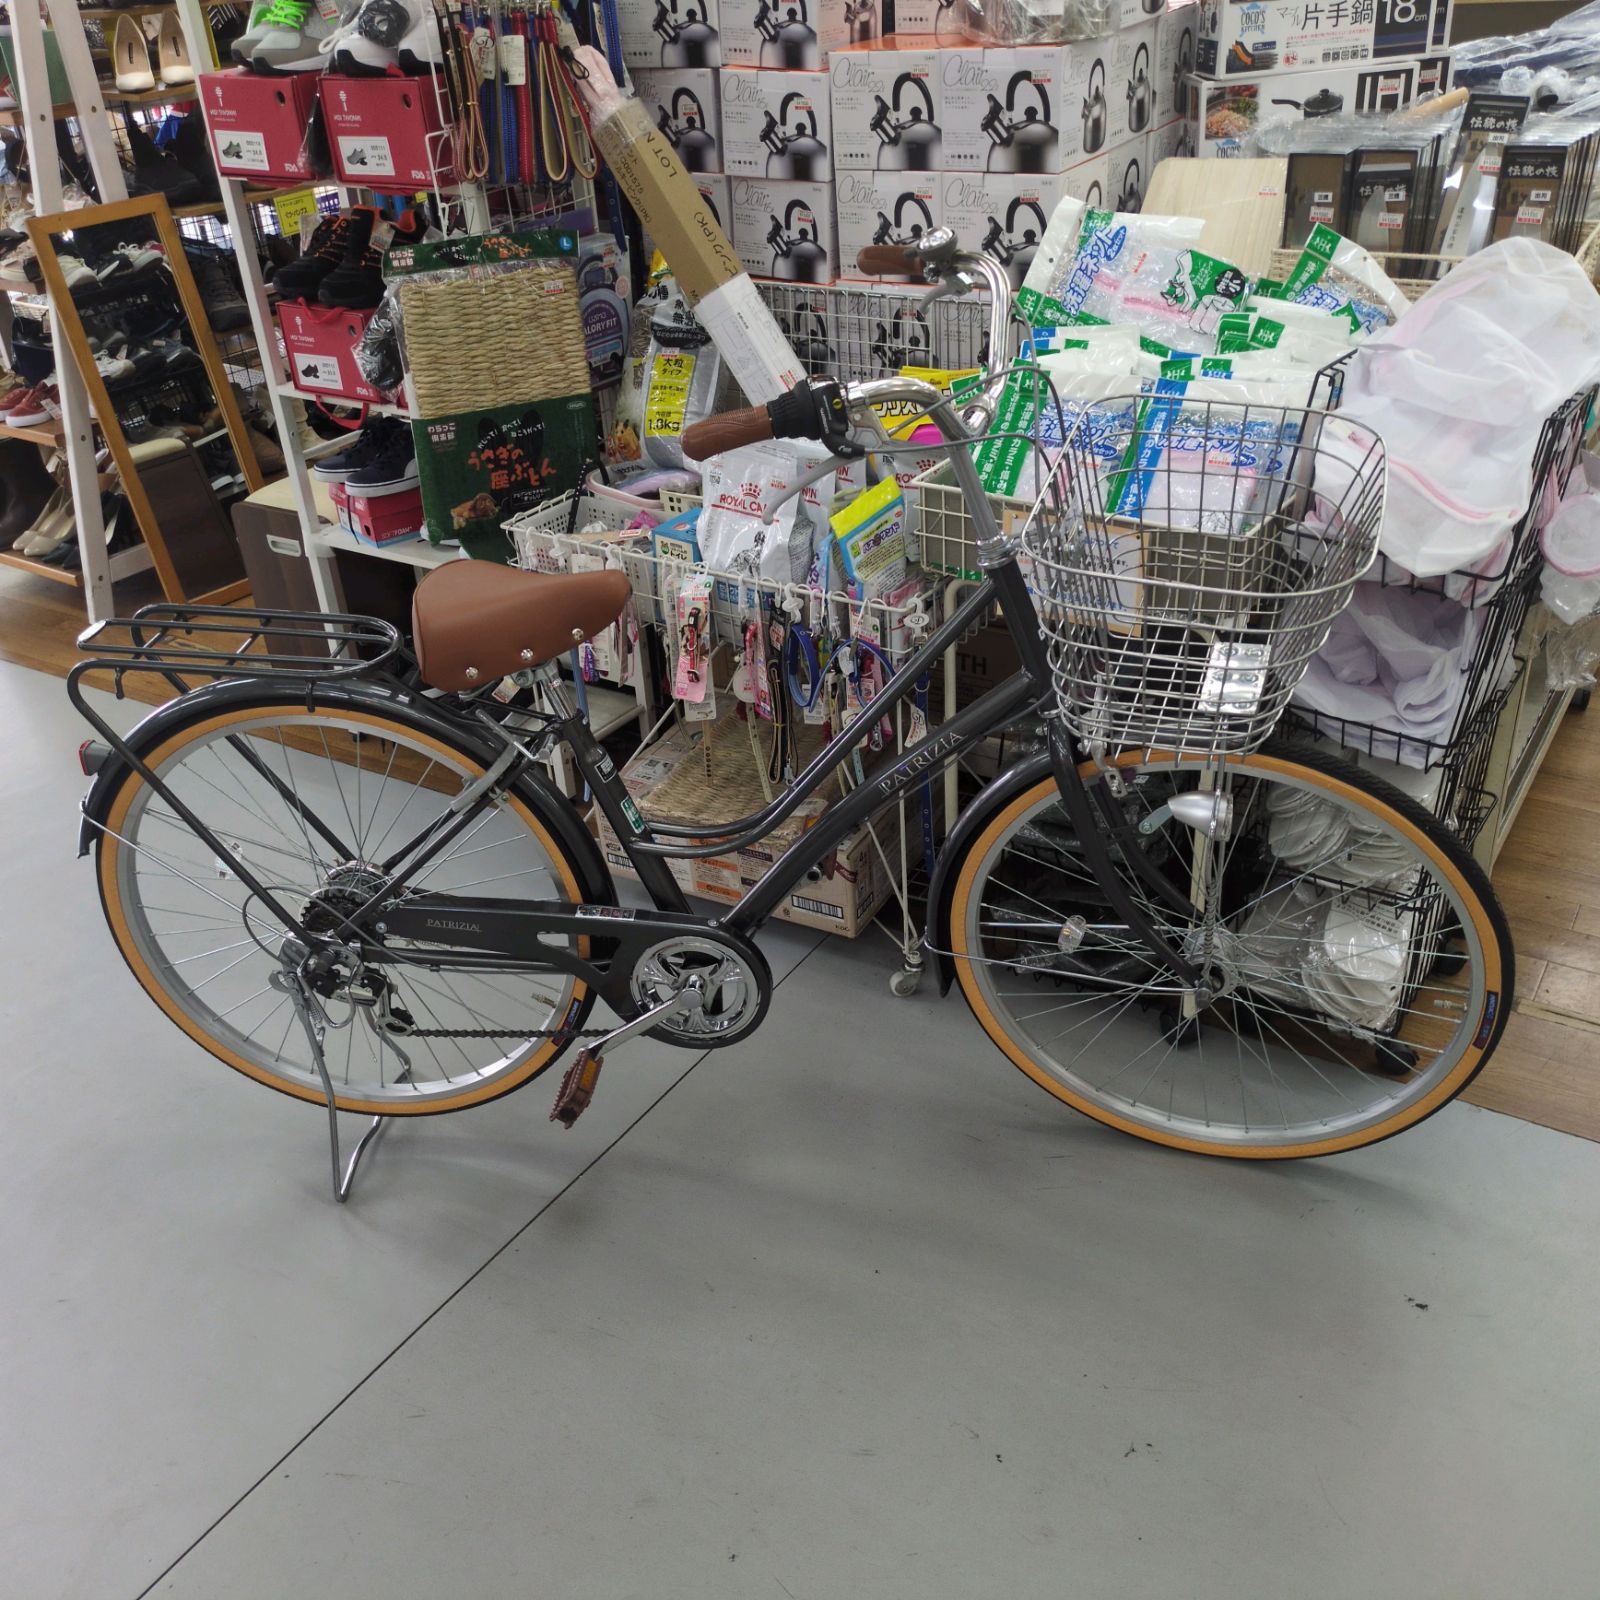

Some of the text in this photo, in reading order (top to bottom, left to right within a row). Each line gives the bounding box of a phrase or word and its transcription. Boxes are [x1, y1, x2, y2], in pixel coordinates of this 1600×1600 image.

[1301, 0, 1374, 31] 片手鍋
[833, 57, 875, 88] Clair
[943, 55, 989, 87] Clair
[653, 147, 678, 178] LOT
[734, 178, 770, 208] Clair
[838, 174, 879, 204] Clair
[945, 177, 989, 208] Clair
[561, 238, 571, 247] L
[663, 358, 685, 368] 大粒
[427, 422, 457, 434] わらっこ
[467, 443, 524, 471] うさぎの
[490, 457, 557, 491] 座ぶとん
[719, 493, 747, 510] ROYAL
[878, 732, 964, 796] PATRIZIA
[426, 918, 480, 931] PATRIZIA
